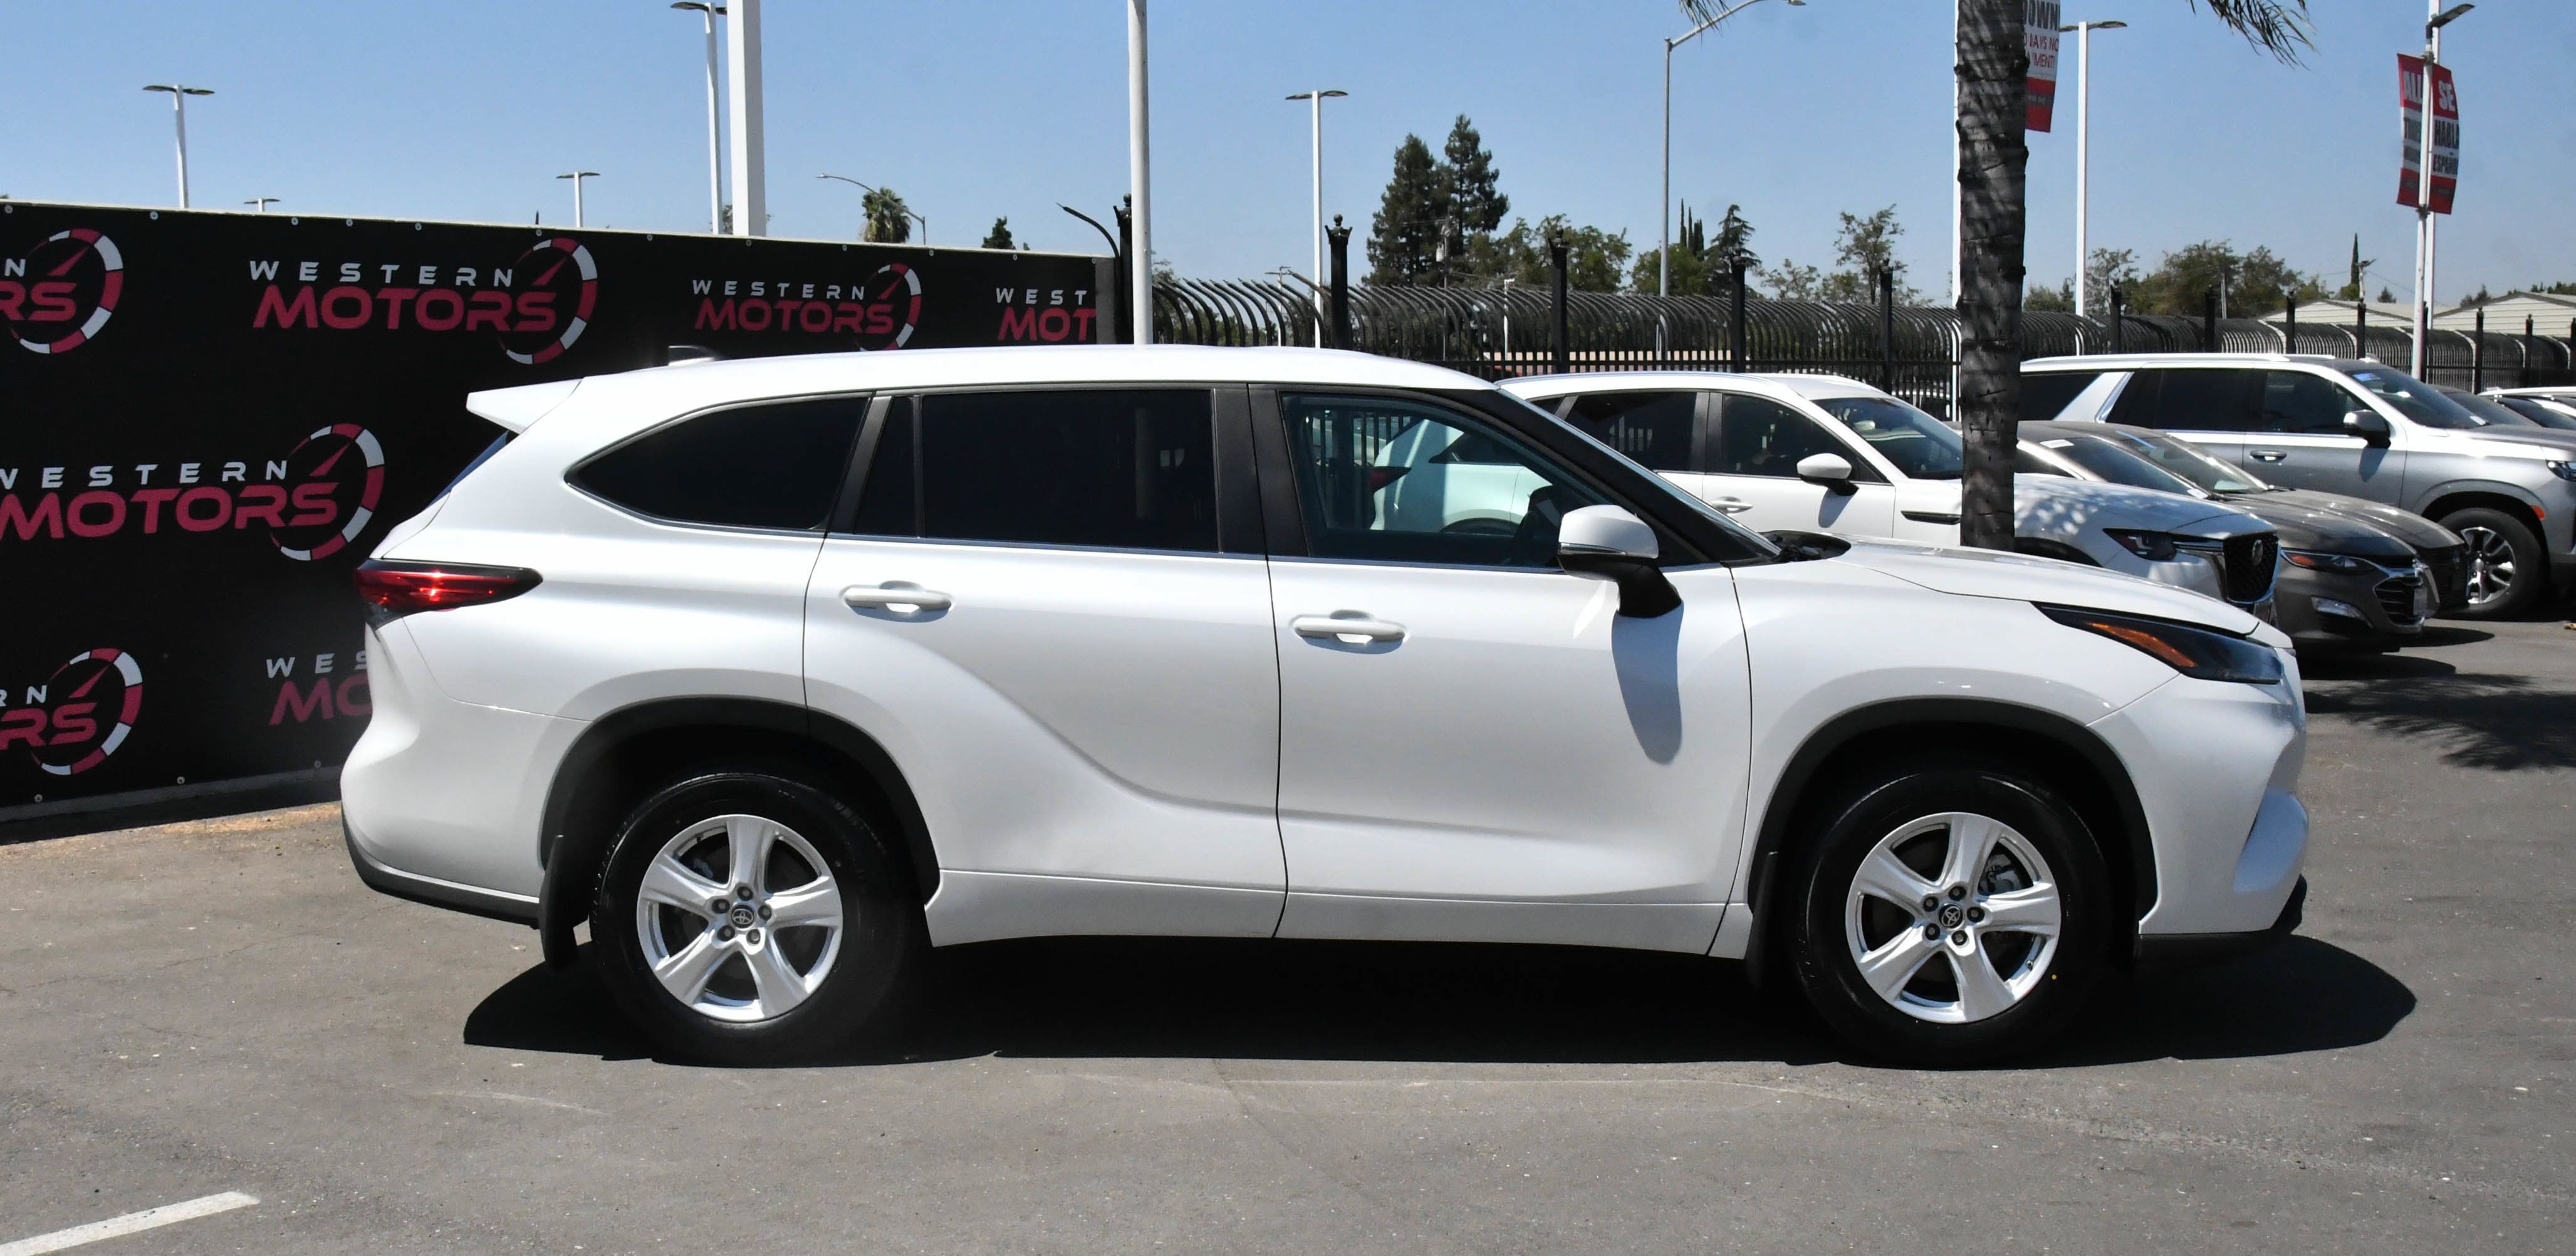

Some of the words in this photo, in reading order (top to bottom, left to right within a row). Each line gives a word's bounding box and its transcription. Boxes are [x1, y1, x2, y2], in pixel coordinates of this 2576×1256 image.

[2439, 80, 2456, 112] SE
[250, 260, 513, 287] WESTERN
[692, 280, 865, 300] WESTERN
[253, 284, 556, 332] MOTORS
[996, 288, 1087, 305] WEST
[695, 298, 894, 334] MOTORS
[998, 307, 1096, 341] MOT
[0, 482, 340, 540] MOTORS
